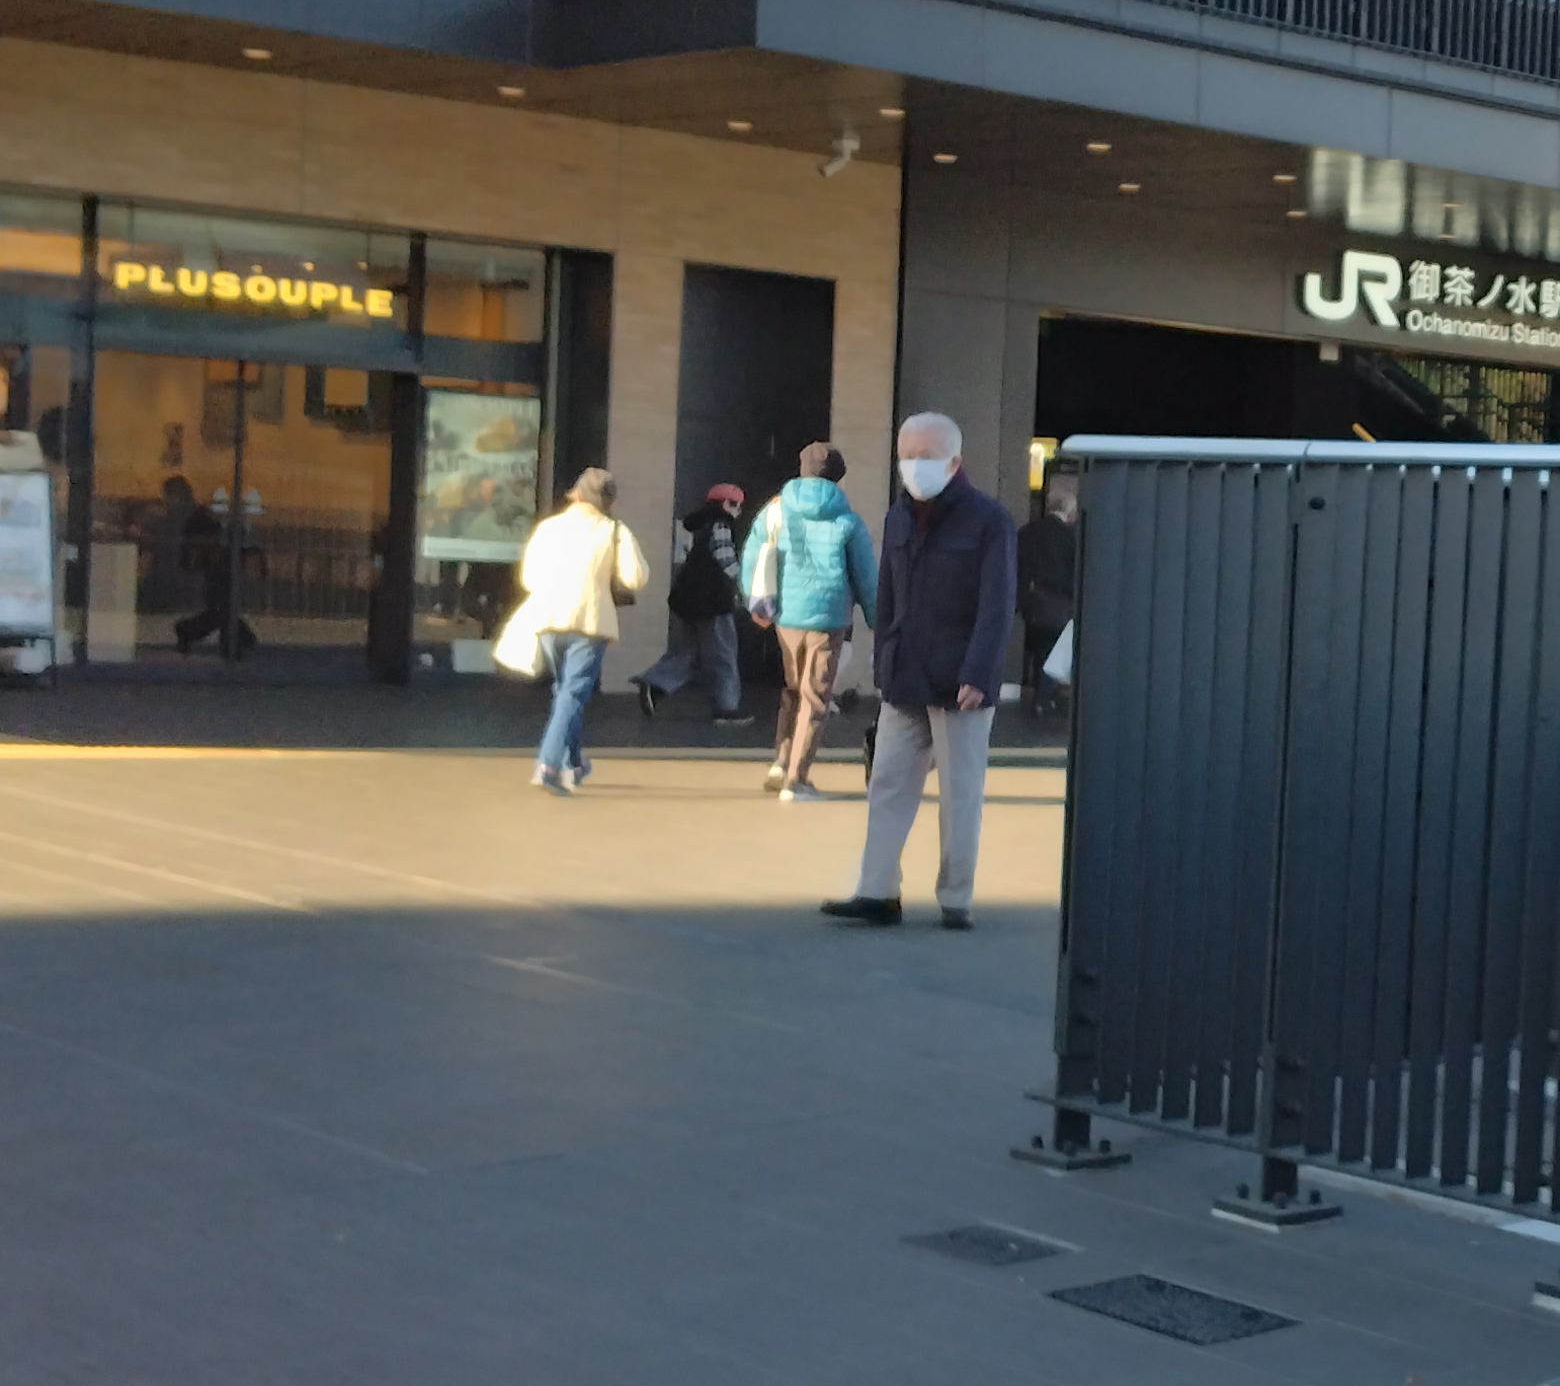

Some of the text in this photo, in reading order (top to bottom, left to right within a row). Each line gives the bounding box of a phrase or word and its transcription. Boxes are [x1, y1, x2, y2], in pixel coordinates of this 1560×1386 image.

[114, 261, 395, 318] PLUSOUPLE
[1303, 250, 1403, 329] JR
[1406, 308, 1510, 342] Ochanomizu
